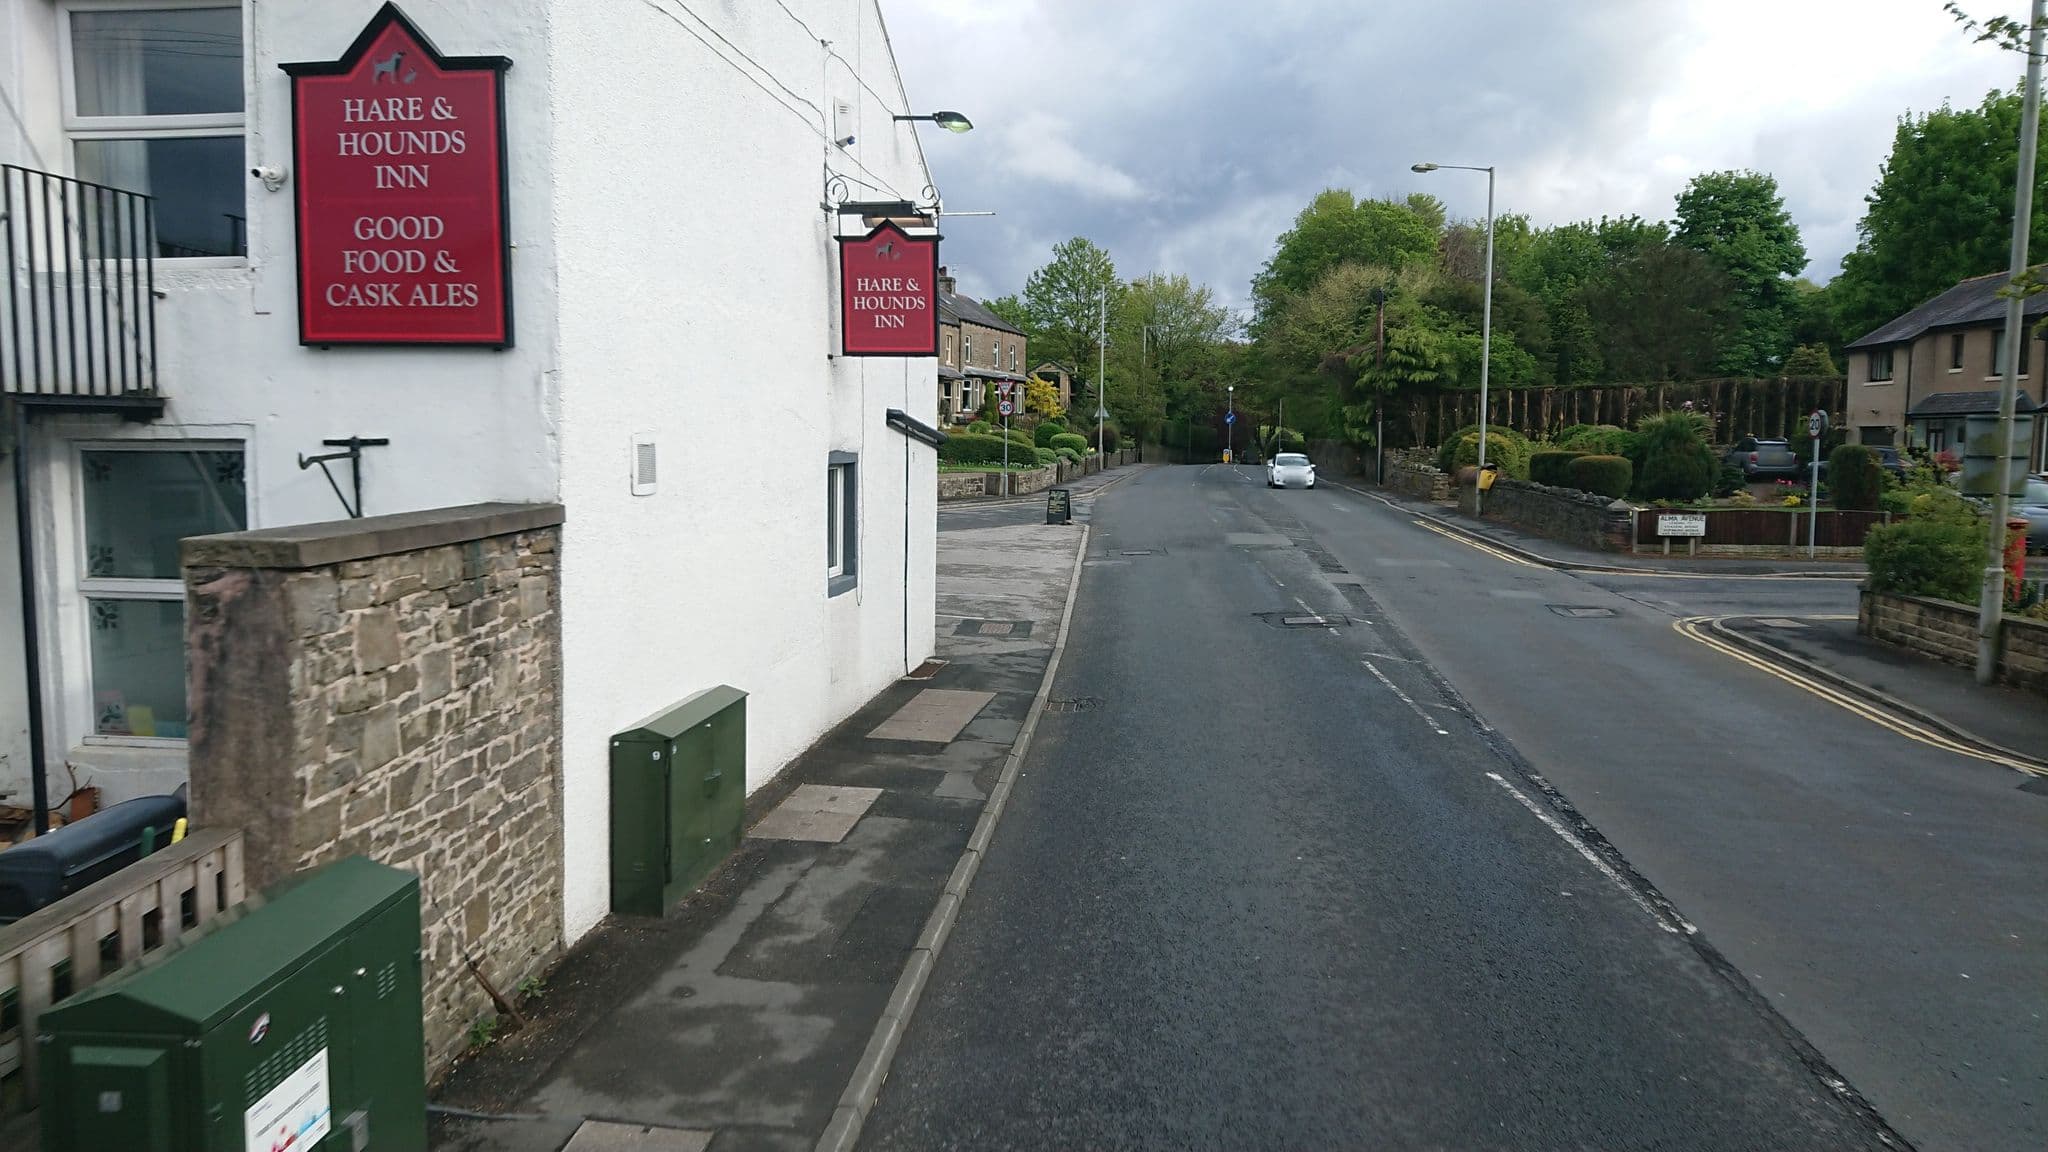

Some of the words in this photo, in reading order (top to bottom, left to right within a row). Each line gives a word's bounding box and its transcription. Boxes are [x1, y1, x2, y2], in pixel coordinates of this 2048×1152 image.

[343, 97, 424, 122] HARE
[431, 96, 457, 121] &
[337, 130, 466, 156] HOUNDS
[374, 165, 429, 189] INN
[353, 216, 444, 240] GOOD
[343, 250, 426, 274] FOOD
[433, 250, 460, 273] &
[325, 283, 402, 308] CASK
[408, 283, 479, 307] ALES
[857, 278, 902, 292] HARE
[906, 278, 921, 292] &
[853, 296, 926, 310] HOUNDS
[874, 314, 905, 329] INN
[1000, 404, 1011, 412] 30
[1810, 418, 1820, 430] 20
